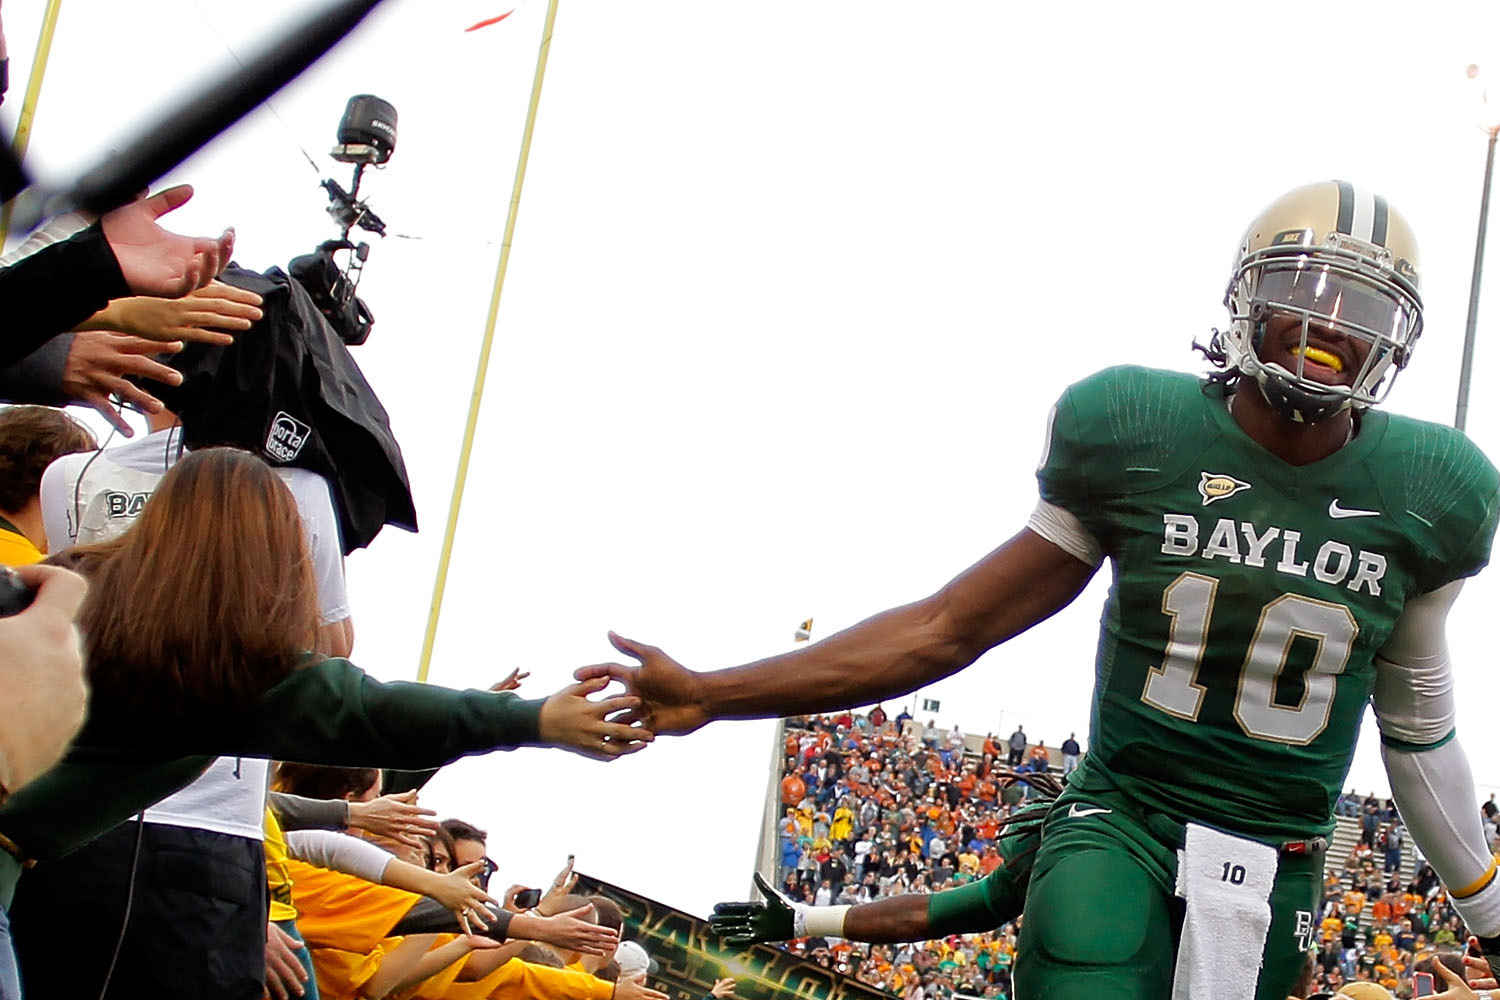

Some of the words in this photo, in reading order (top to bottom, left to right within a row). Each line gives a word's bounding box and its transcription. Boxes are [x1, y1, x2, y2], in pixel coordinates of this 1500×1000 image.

[269, 438, 294, 460] brace
[272, 423, 302, 449] porta
[105, 491, 153, 519] BA
[1161, 514, 1387, 597] BAYLOR
[1141, 571, 1360, 746] 10
[1221, 861, 1247, 886] 10
